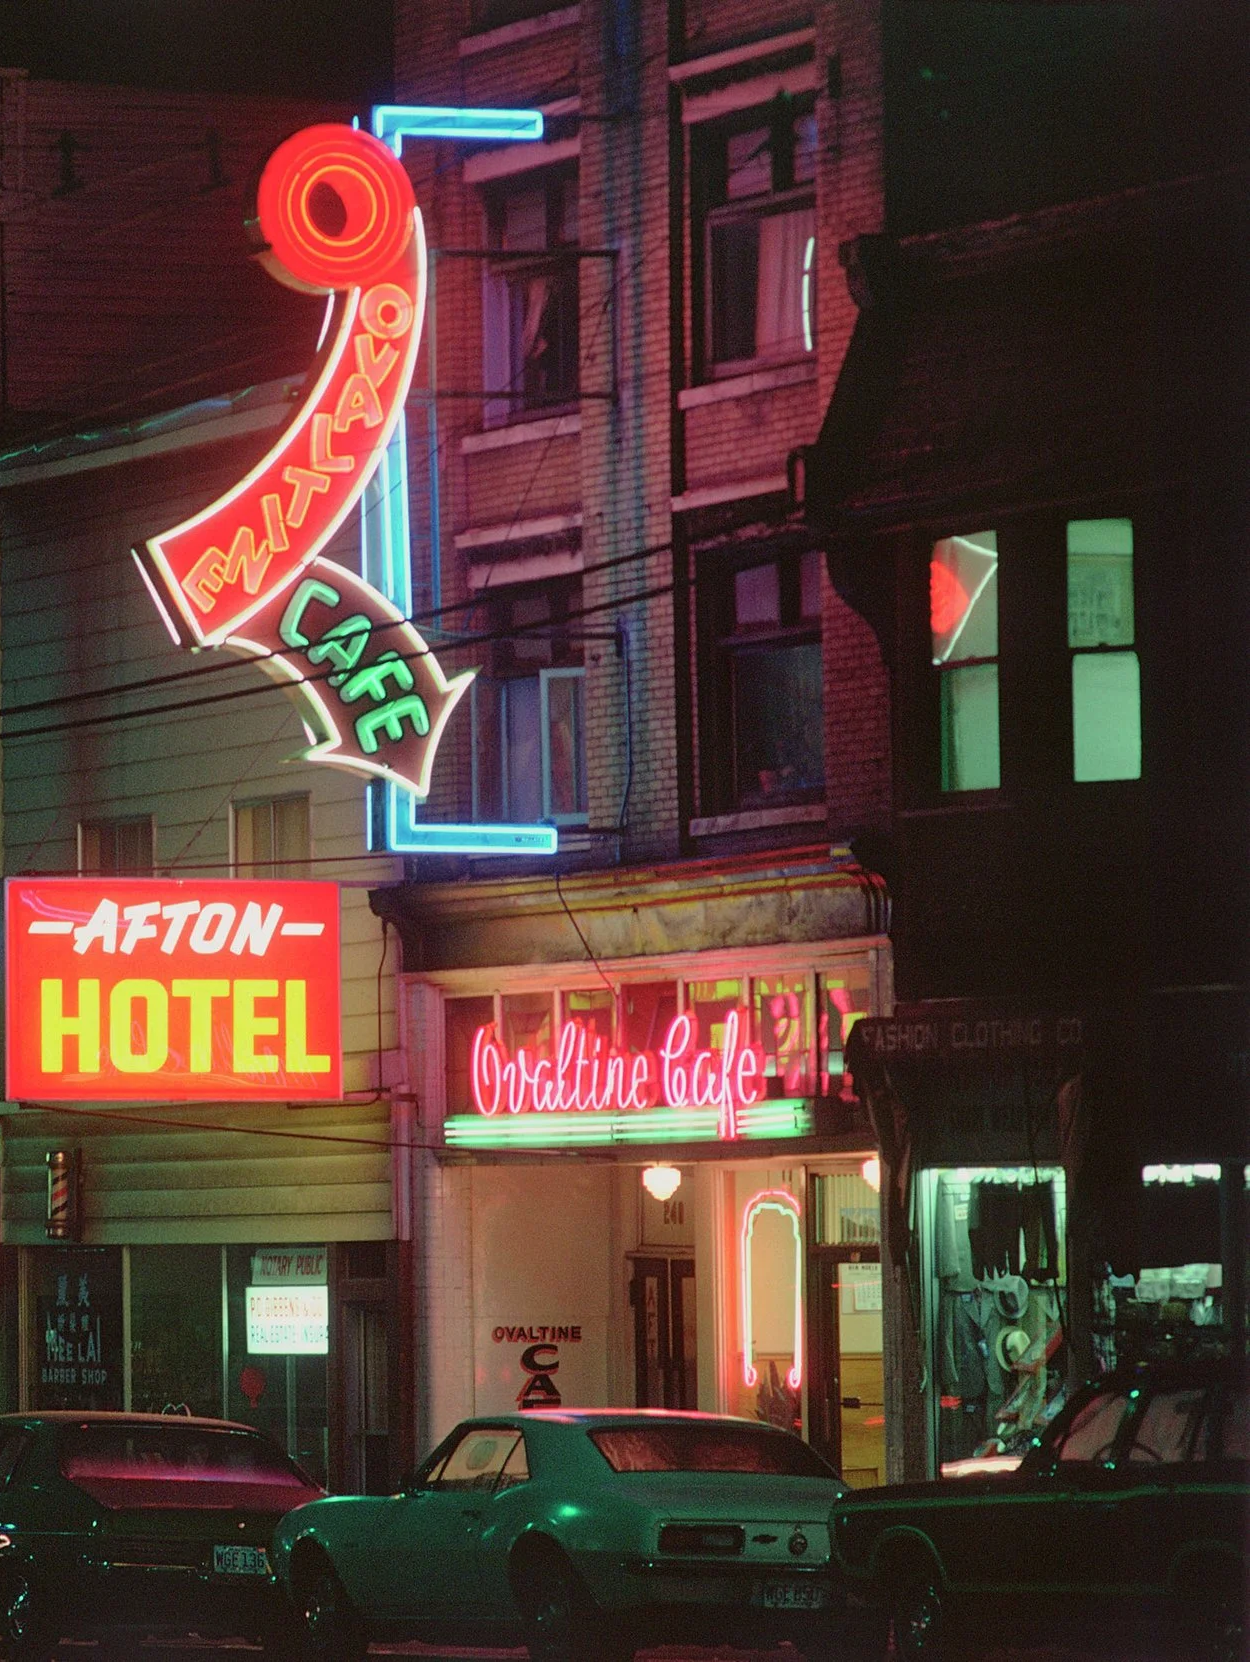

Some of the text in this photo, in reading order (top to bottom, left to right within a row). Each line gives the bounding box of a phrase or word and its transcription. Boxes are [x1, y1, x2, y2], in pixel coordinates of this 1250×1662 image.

[181, 283, 414, 613] OVALTINE
[277, 577, 431, 755] CAFE
[73, 897, 284, 957] AFTON
[40, 978, 332, 1074] HOTEL
[861, 1022, 938, 1053] FASHION
[950, 1018, 1041, 1049] CLOTHING
[470, 1009, 760, 1139] Ovaltine Cafe
[259, 1253, 323, 1277] NOTARY PUBLIC
[492, 1325, 582, 1343] OVALTINE
[41, 1367, 108, 1385] BARBER SHOP
[516, 1343, 562, 1409] CA
